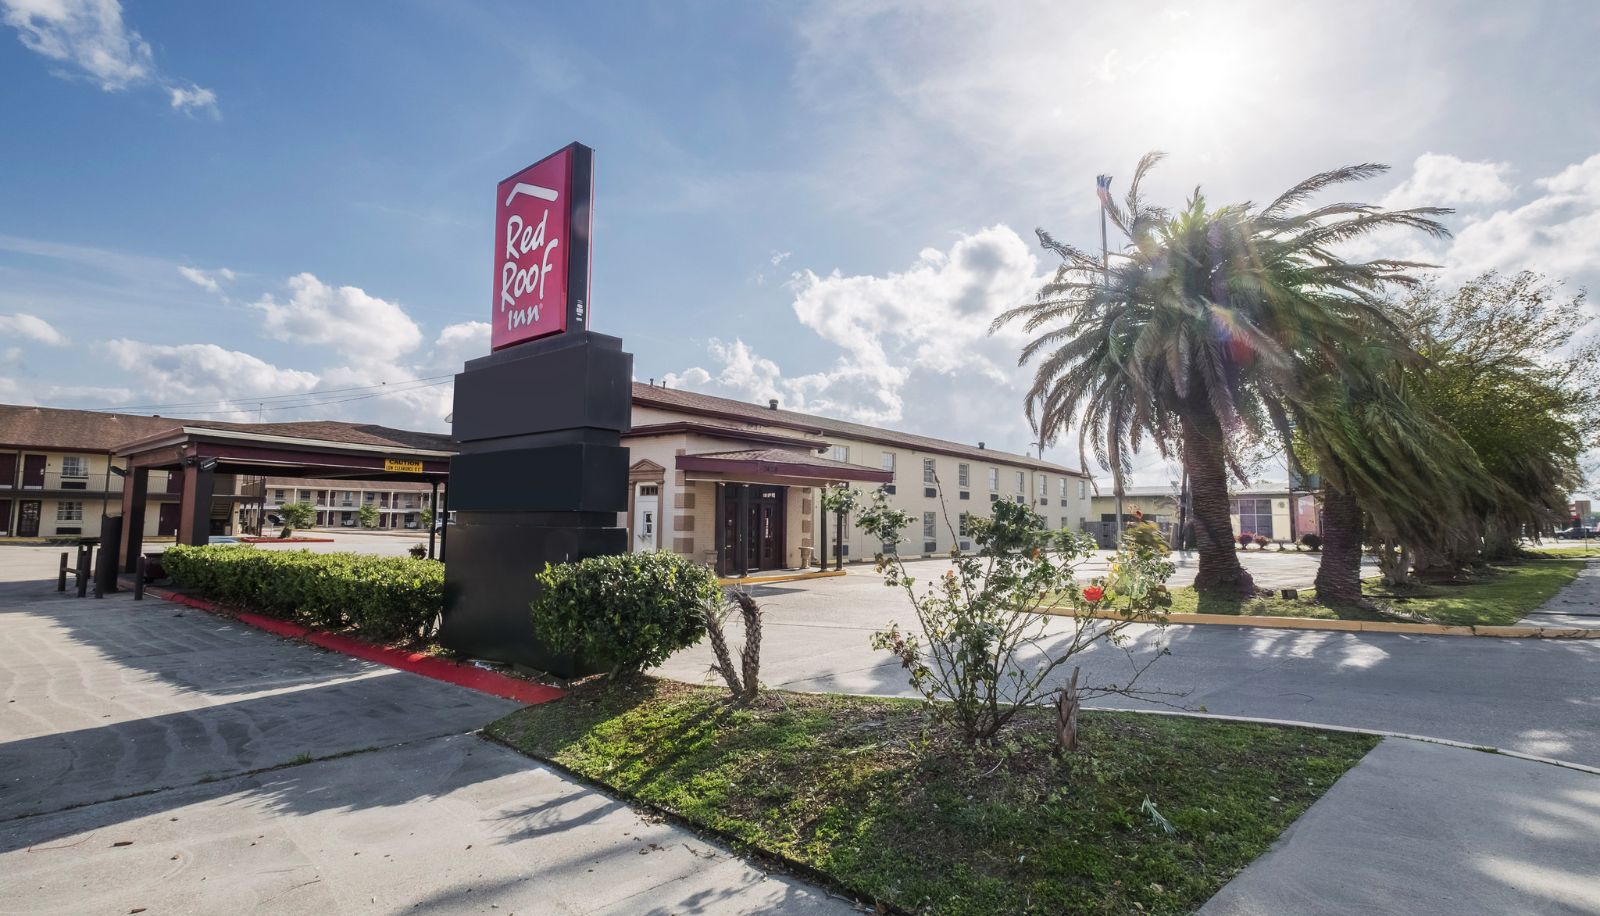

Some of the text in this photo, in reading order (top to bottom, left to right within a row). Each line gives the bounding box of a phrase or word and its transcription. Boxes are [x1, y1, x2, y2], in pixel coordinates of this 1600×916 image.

[506, 209, 548, 259] Red
[501, 238, 558, 312] Roof
[389, 458, 419, 466] CAUTION
